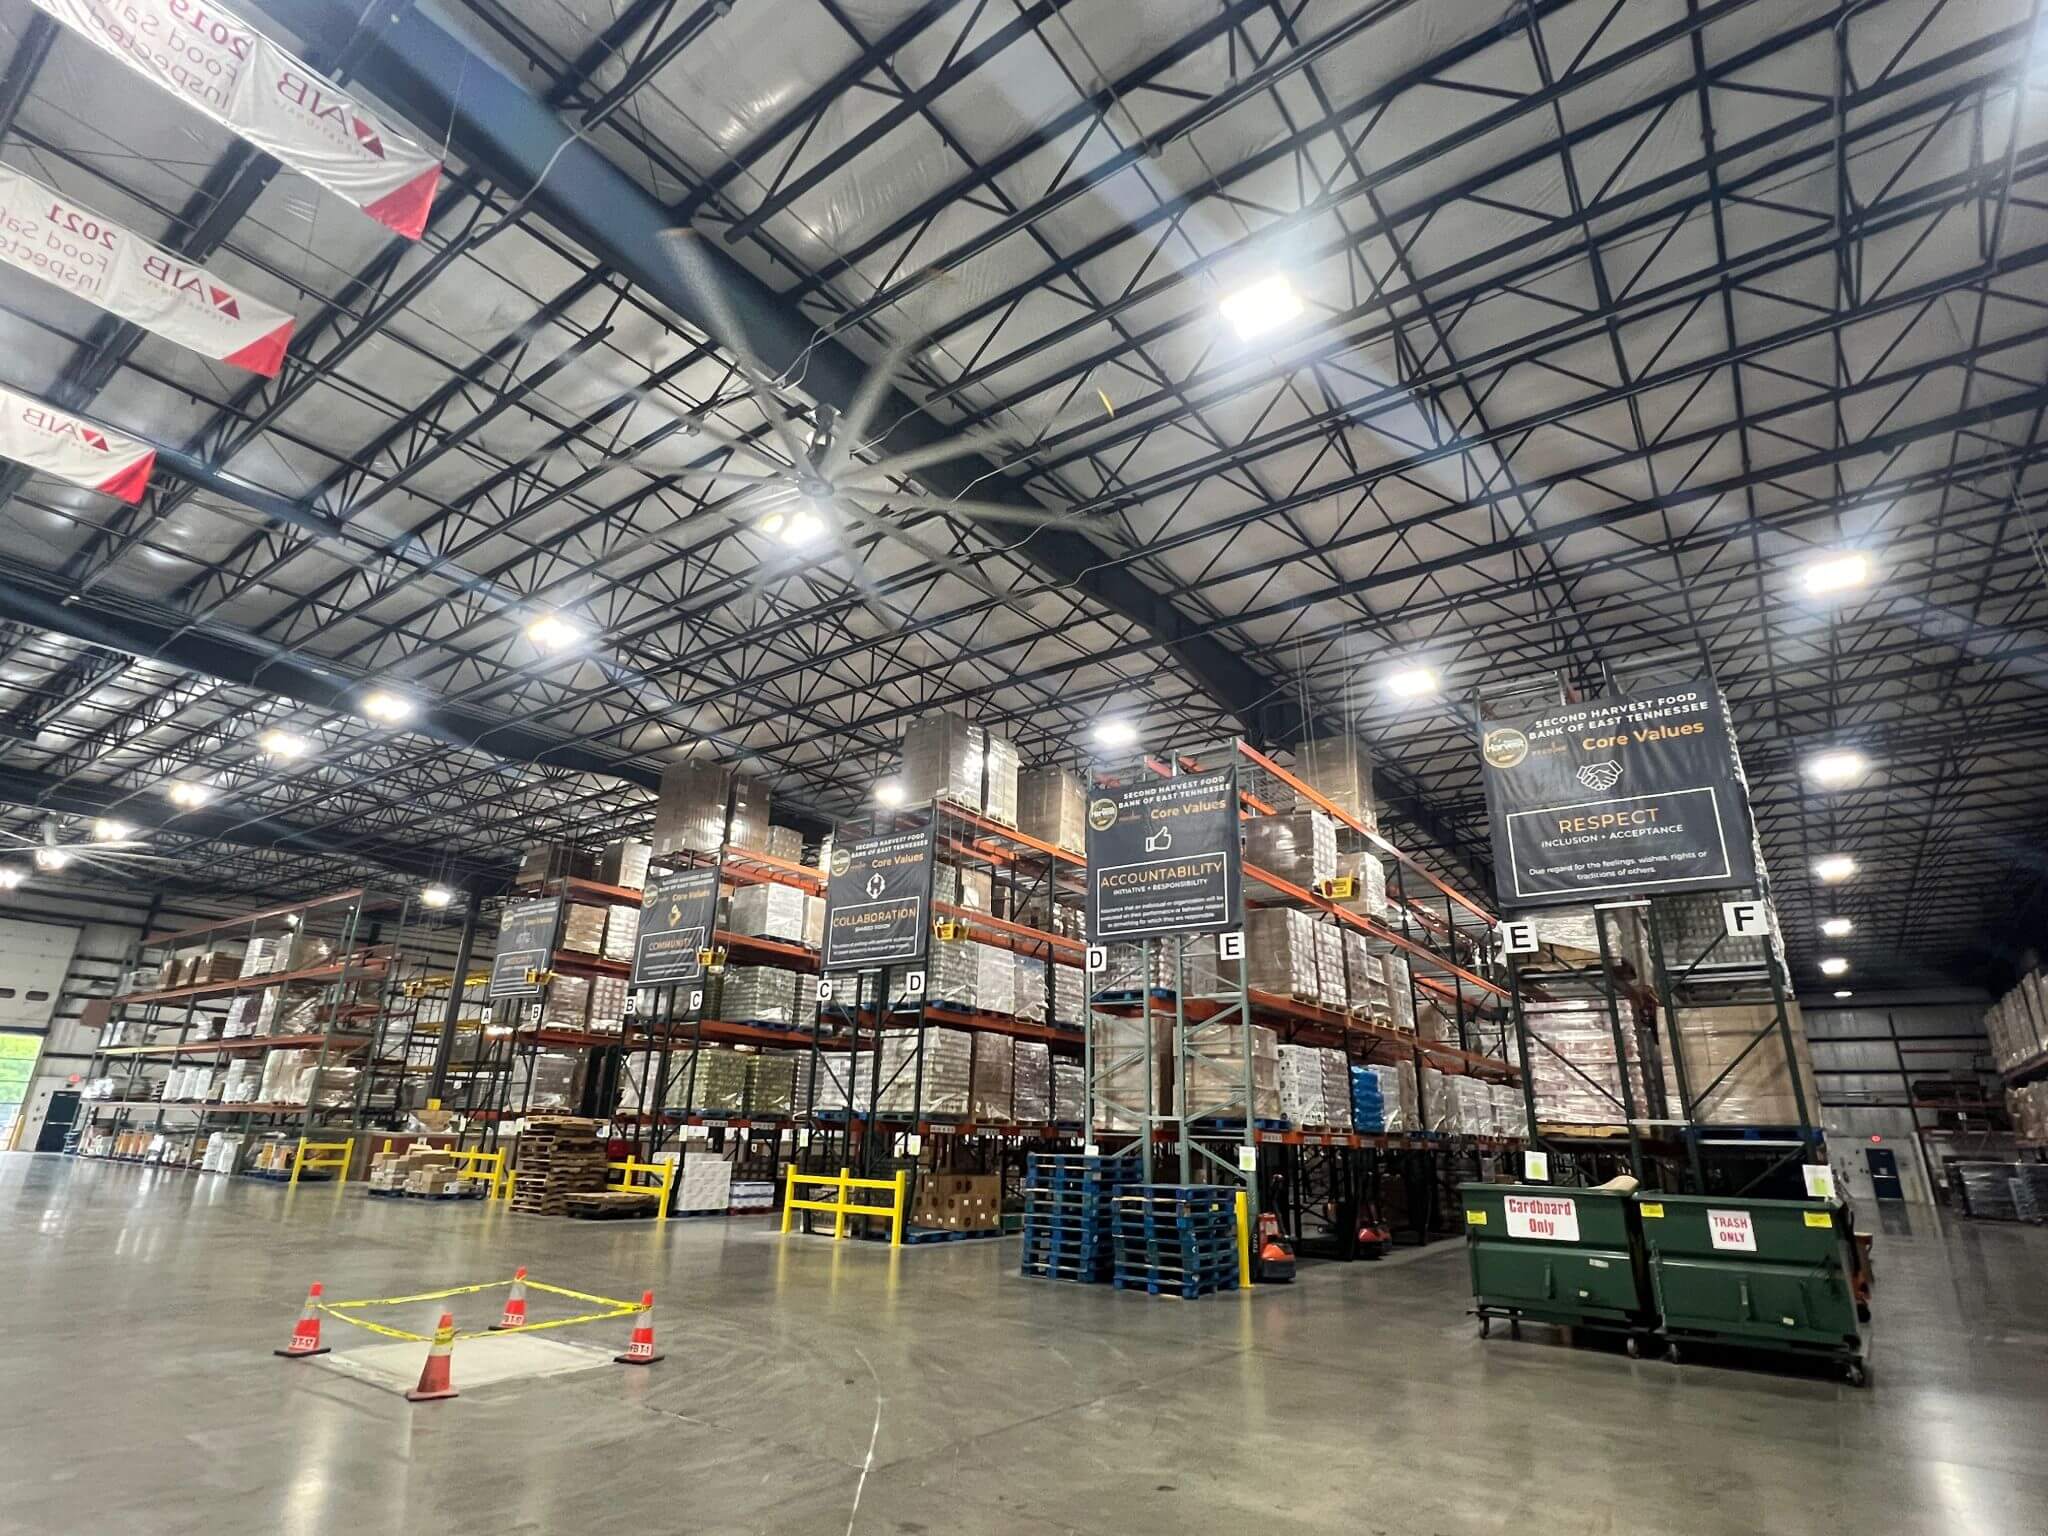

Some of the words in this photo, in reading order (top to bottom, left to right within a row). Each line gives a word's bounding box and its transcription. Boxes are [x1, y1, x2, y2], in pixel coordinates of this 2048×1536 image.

[1535, 712, 1587, 728] SECOND
[1591, 700, 1653, 718] HARVEST
[1657, 692, 1697, 706] FOOD
[1528, 727, 1564, 740] BANK
[1567, 723, 1585, 733] OF
[1588, 716, 1622, 729] EAST
[1626, 701, 1709, 722] TENNESSEE
[1582, 735, 1629, 751] Core
[1633, 722, 1705, 742] Values
[1118, 800, 1141, 809] BANK
[1156, 793, 1178, 802] EAST
[1180, 783, 1231, 798] TENNESSEE
[1123, 788, 1156, 800] SECOND
[1159, 780, 1198, 794] HARVEST
[1200, 775, 1225, 785] FOOD
[1150, 808, 1180, 820] Core
[1183, 799, 1227, 814] Values
[1558, 807, 1659, 834] RESPECT
[1541, 834, 1598, 848] INCLUSION
[1609, 824, 1684, 840] ACCEPTANCE
[871, 859, 892, 869] Core
[893, 853, 924, 865] Values
[1100, 861, 1222, 888] ACCOUNTABILITY
[1113, 886, 1146, 895] INITIATIVE
[1152, 878, 1208, 891] RESPONSIBILITY
[833, 907, 916, 927] COLLABORATION
[1733, 906, 1754, 931] F
[1226, 936, 1239, 956] E
[1510, 925, 1531, 949] E
[1090, 951, 1103, 969] D
[820, 983, 829, 998] C
[910, 975, 921, 991] D
[626, 999, 634, 1011] B
[693, 994, 700, 1007] C
[483, 1010, 490, 1020] A
[533, 1006, 540, 1018] B
[1508, 1199, 1571, 1216] Cardboard
[1529, 1218, 1554, 1235] Only
[1713, 1217, 1748, 1229] TRASH
[1719, 1232, 1745, 1243] ONLY
